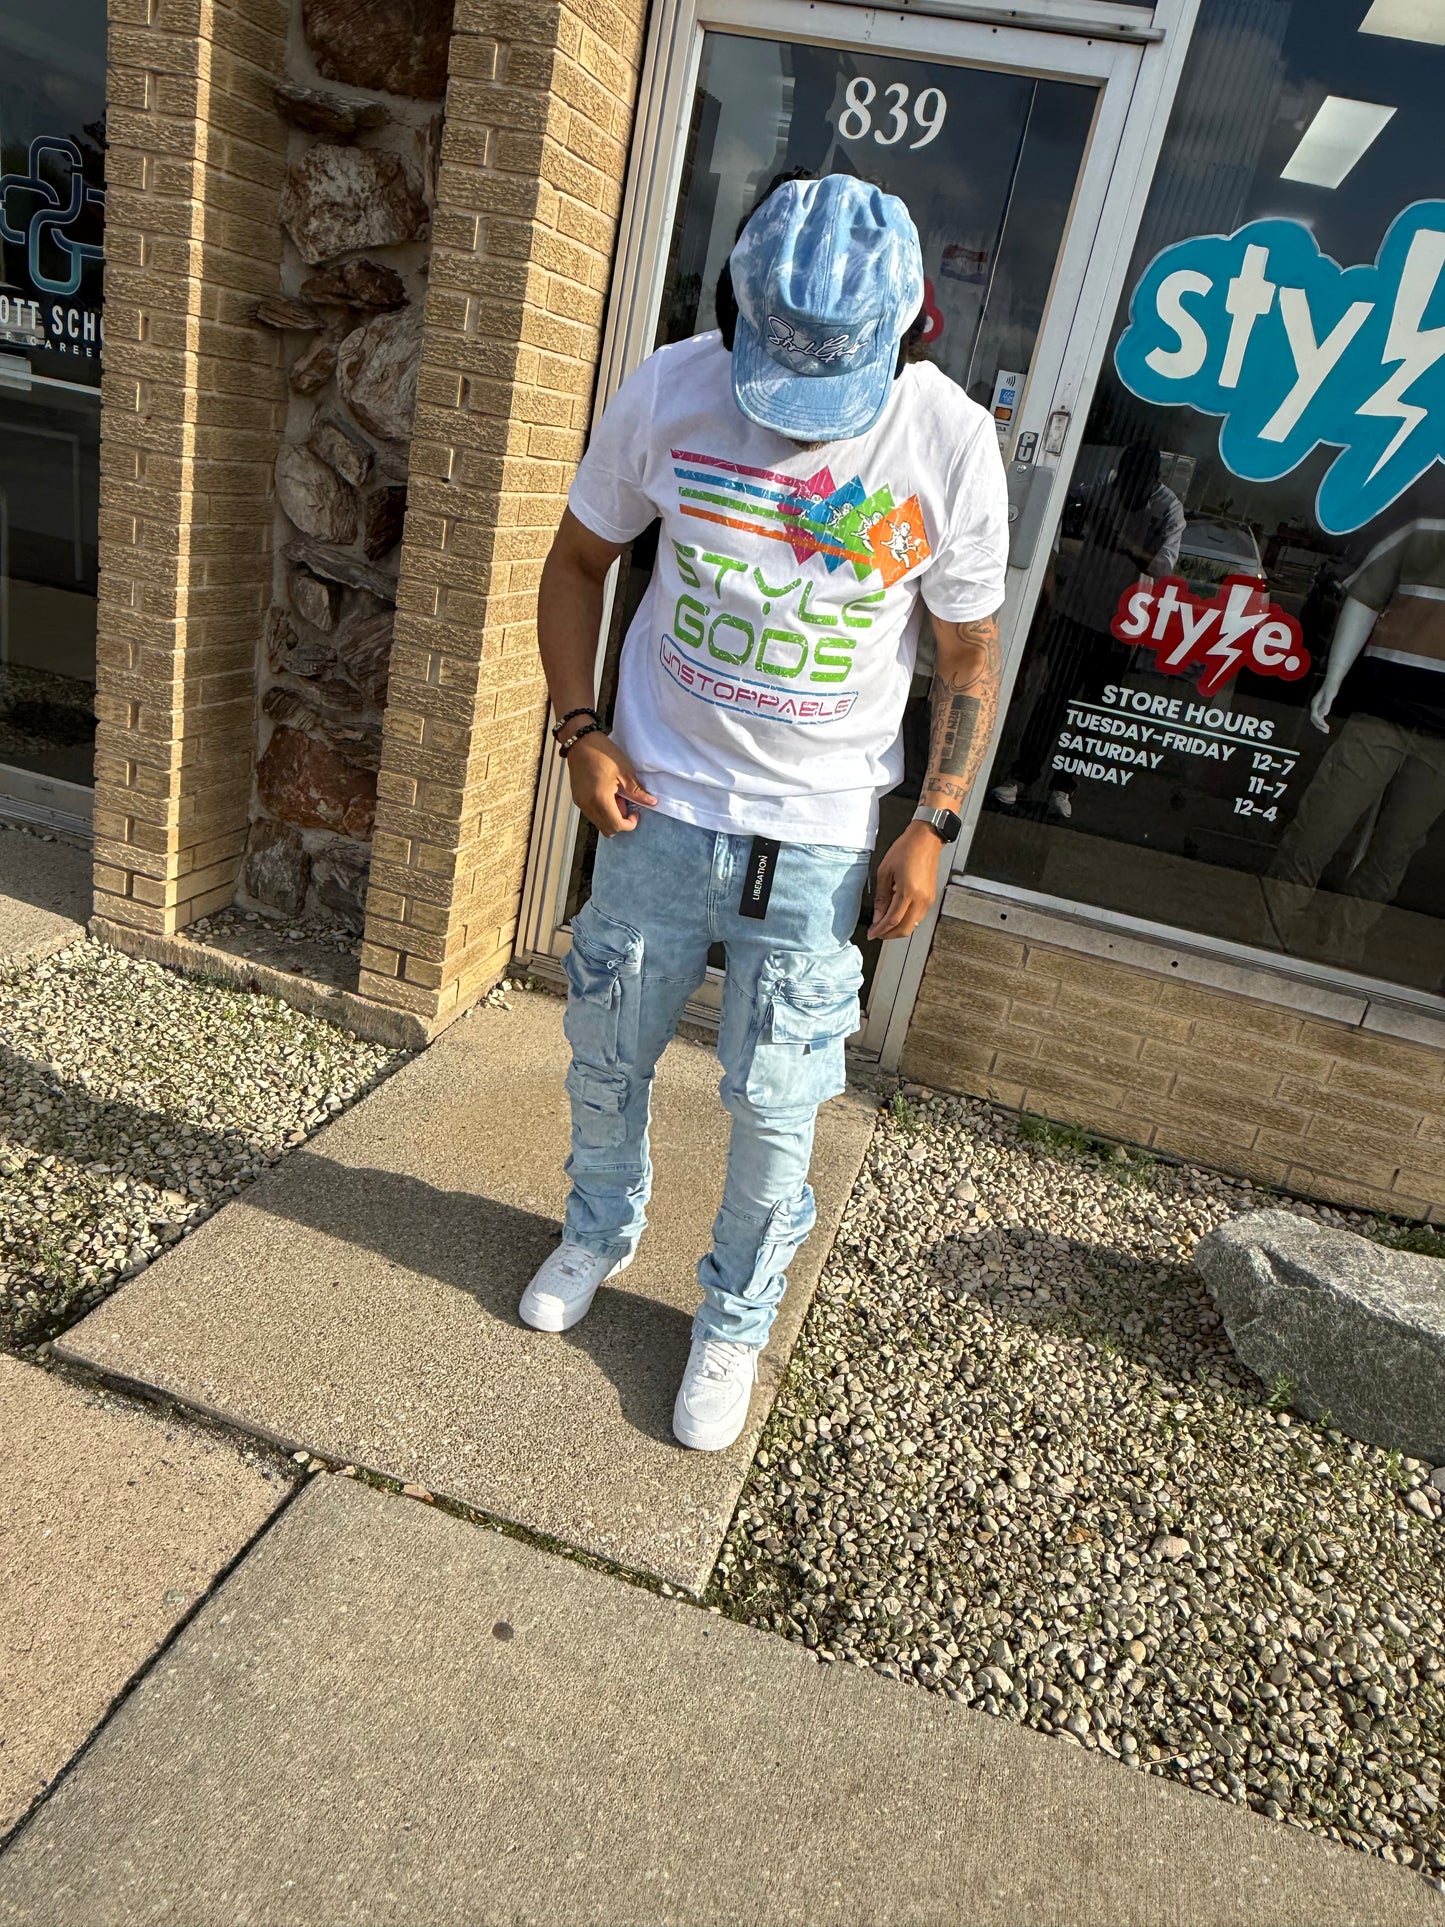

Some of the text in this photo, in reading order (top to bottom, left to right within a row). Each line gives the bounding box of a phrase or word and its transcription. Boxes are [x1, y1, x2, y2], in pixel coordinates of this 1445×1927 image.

[838, 76, 947, 149] 839
[671, 538, 886, 628] STYLE
[673, 594, 857, 683] GODS
[661, 642, 852, 717] UNSTOPPABLE
[1101, 684, 1275, 740] STORE HOURS
[1058, 732, 1288, 799] SATURDAY 11-7
[1066, 709, 1296, 776] TUESDAY-FRIDAY 12-7
[1052, 754, 1279, 822] SUNDAY 12-4
[752, 855, 768, 901] LIBERATION
